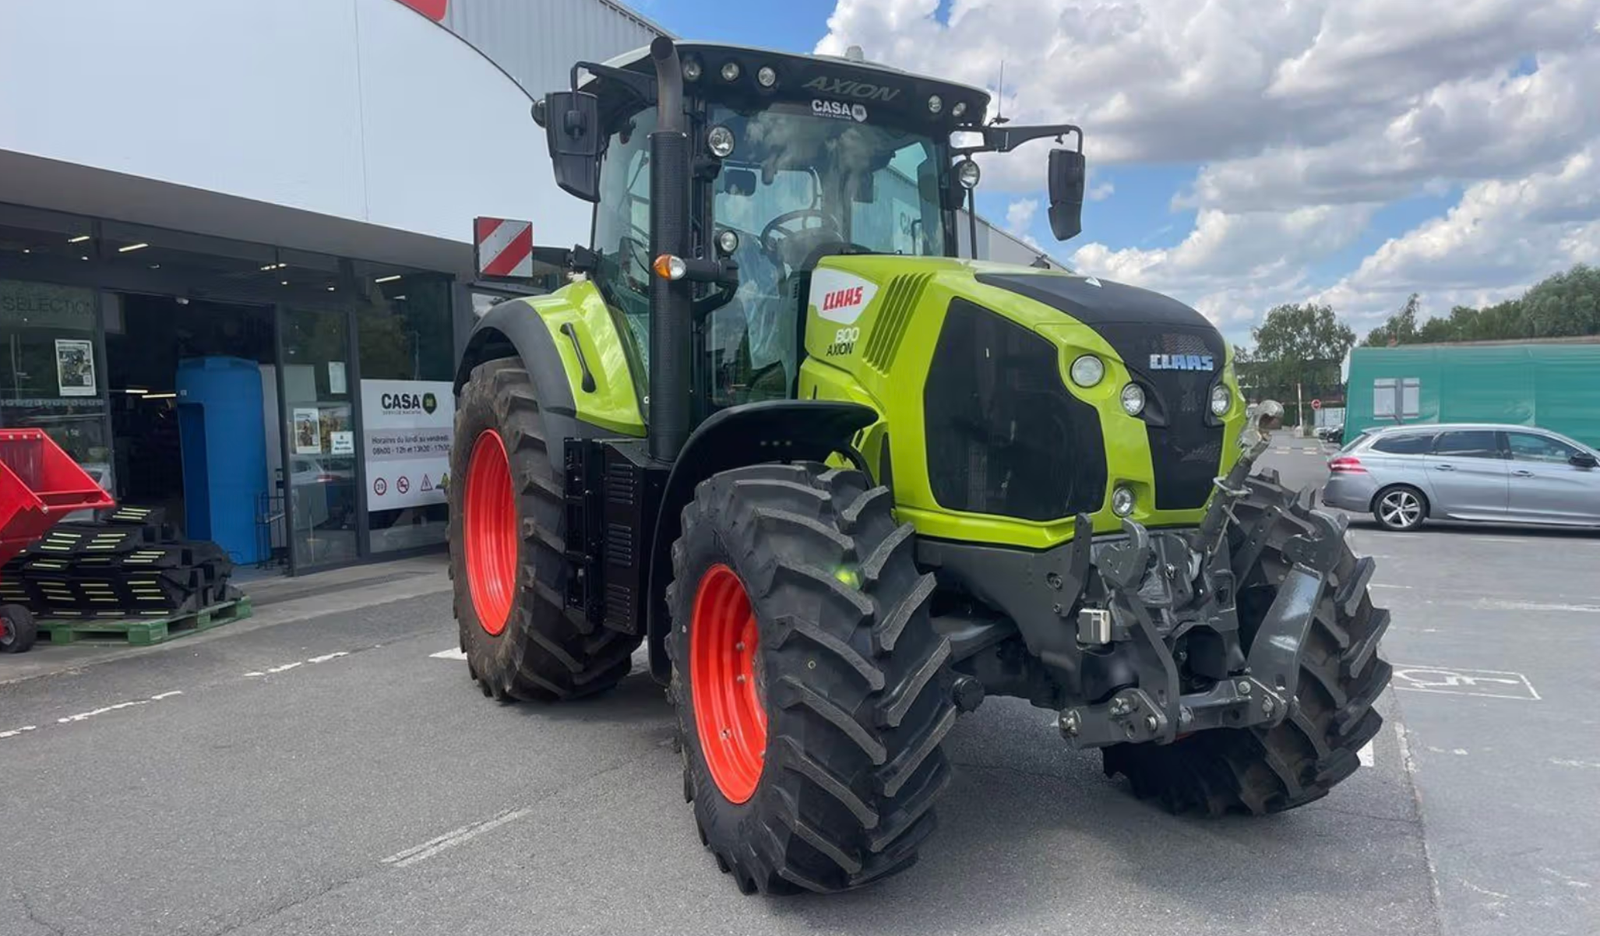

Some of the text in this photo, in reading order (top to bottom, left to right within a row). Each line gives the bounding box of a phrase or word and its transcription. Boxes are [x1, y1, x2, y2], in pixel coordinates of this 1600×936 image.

[801, 76, 900, 101] AXION
[812, 99, 851, 116] CASA
[823, 286, 864, 311] CLAAS
[835, 327, 860, 343] 800
[825, 342, 854, 357] AXION
[1149, 353, 1214, 371] CLAAS
[381, 393, 421, 409] CASA
[397, 436, 404, 444] du
[405, 435, 418, 443] lundi
